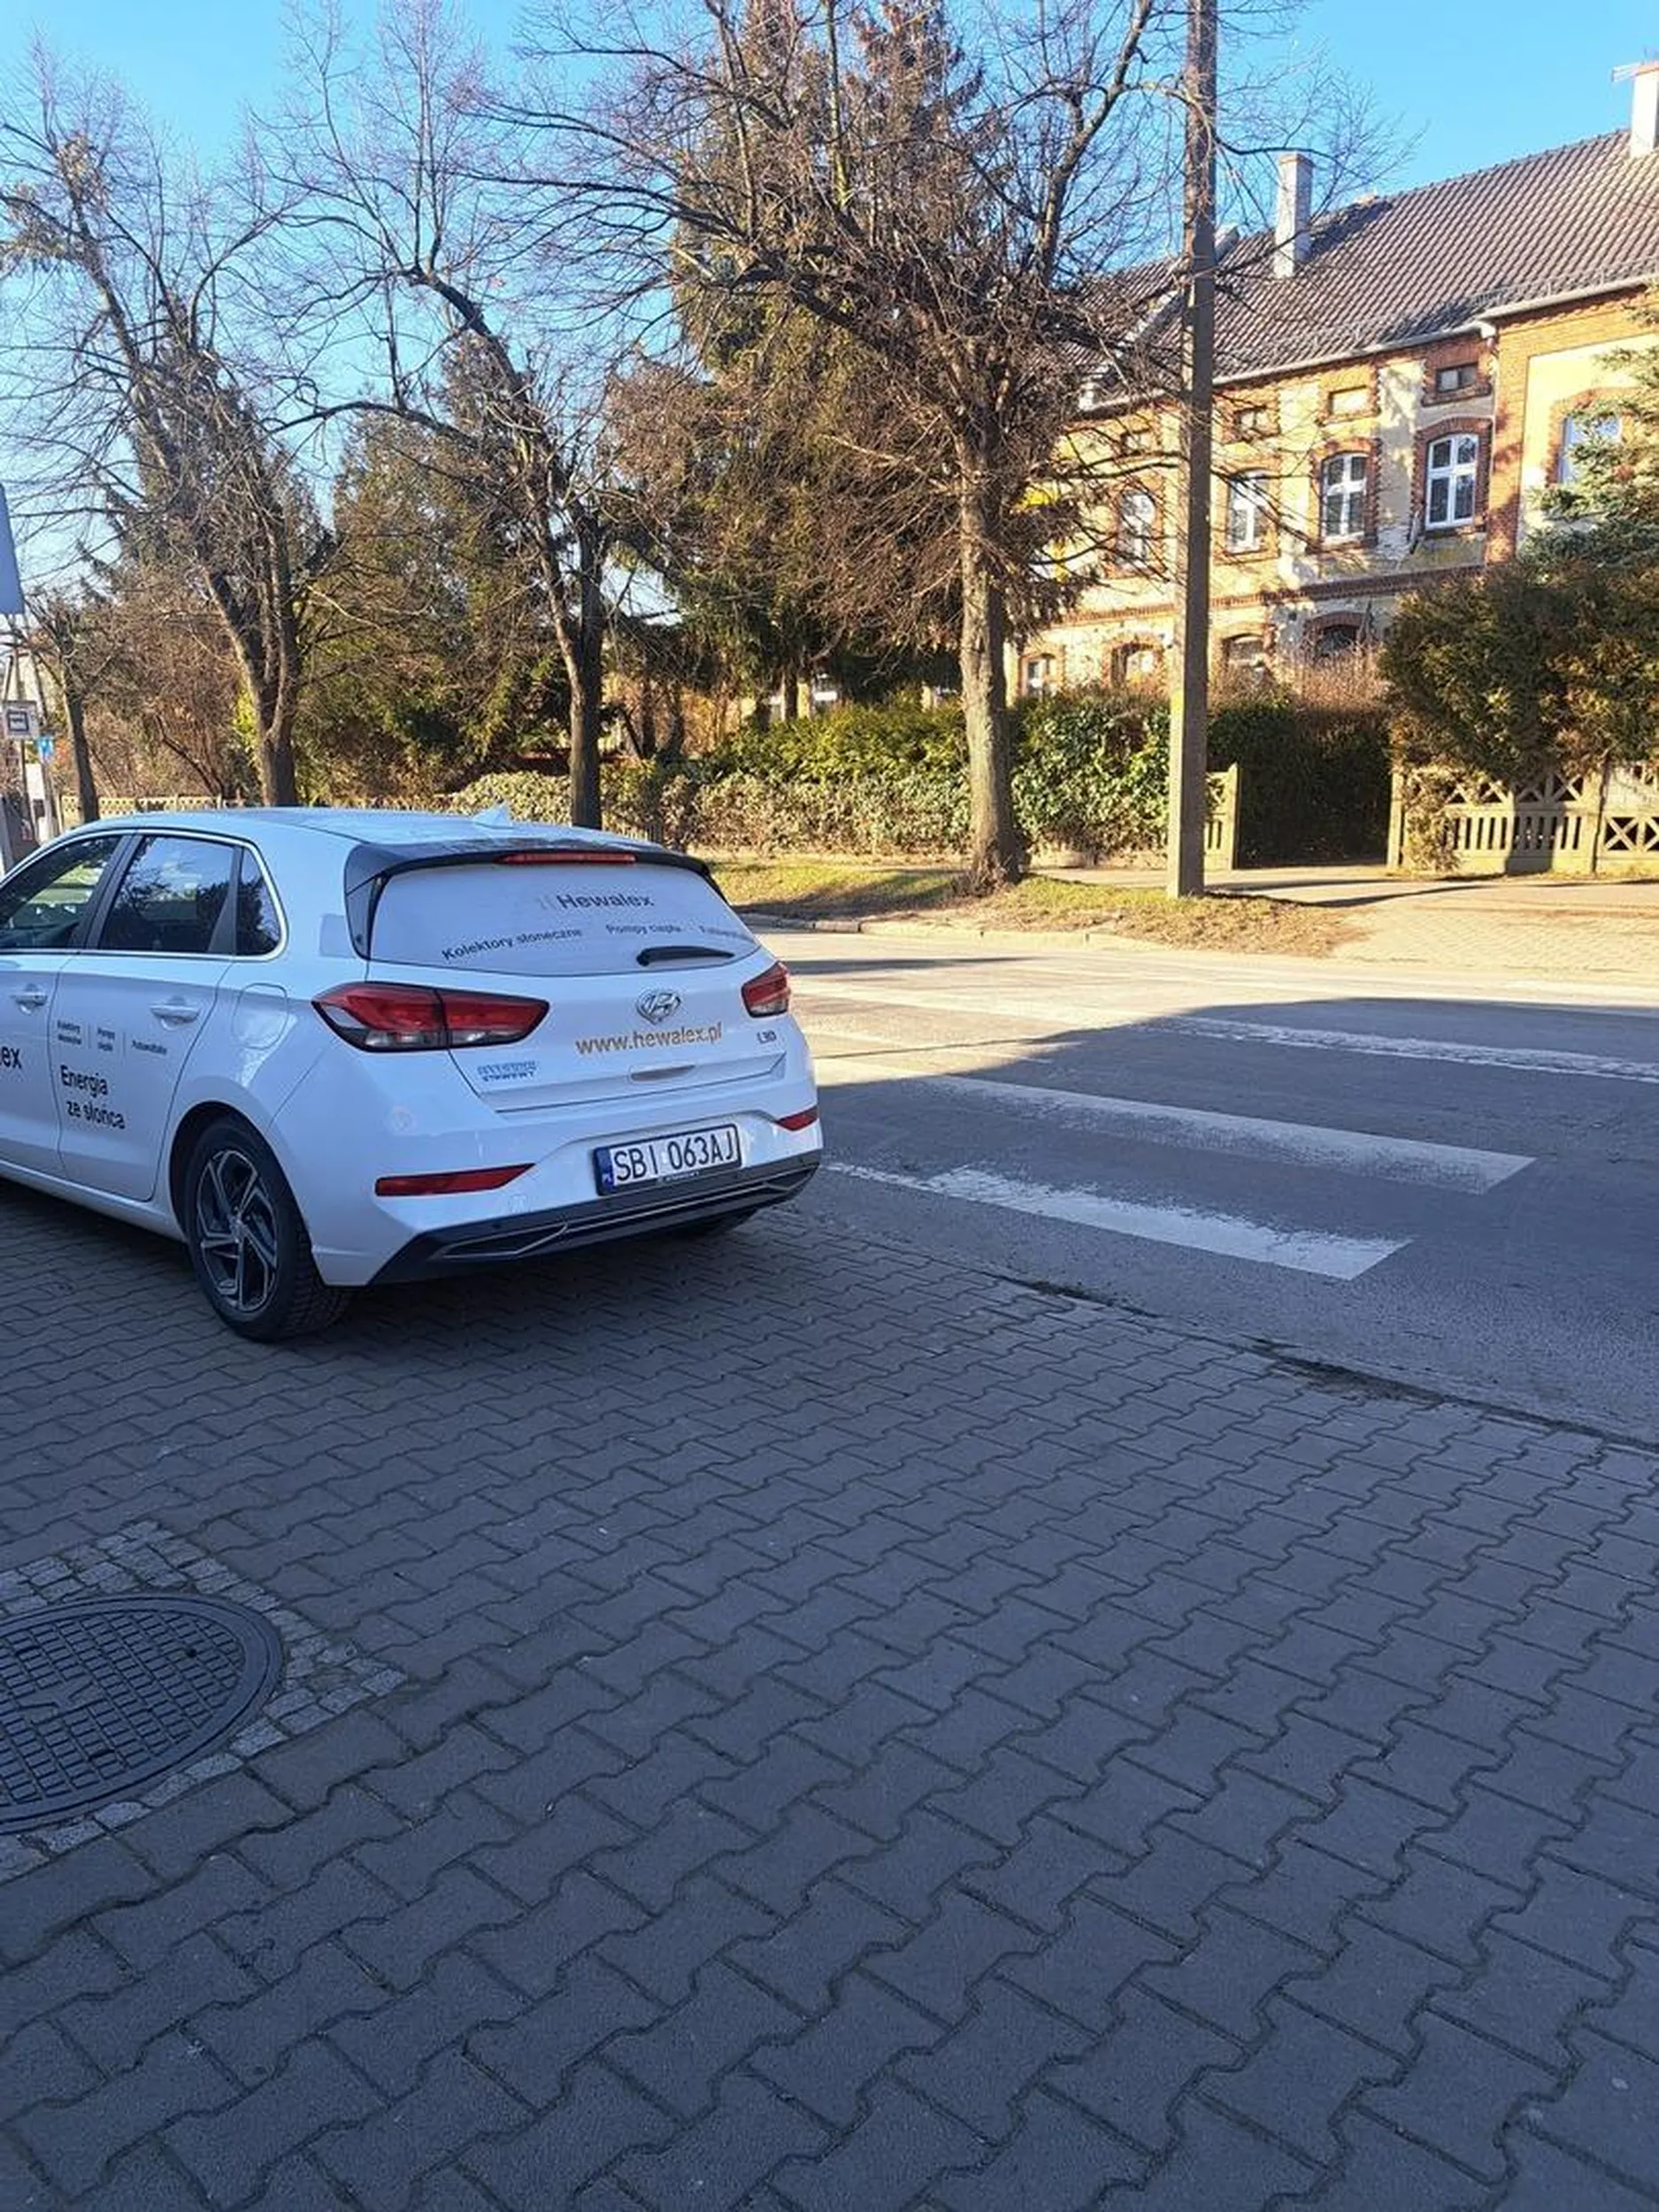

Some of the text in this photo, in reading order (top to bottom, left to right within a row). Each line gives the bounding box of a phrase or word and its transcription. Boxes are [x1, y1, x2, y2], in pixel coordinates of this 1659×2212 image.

[557, 893, 655, 910] Hewalex
[442, 936, 514, 961] Kolektory
[574, 1022, 723, 1055] www.hewalex.pl
[0, 1046, 22, 1070] ex
[60, 1064, 109, 1098] Energia
[66, 1101, 81, 1118] ze
[613, 1131, 734, 1182] SBI 063AJ
